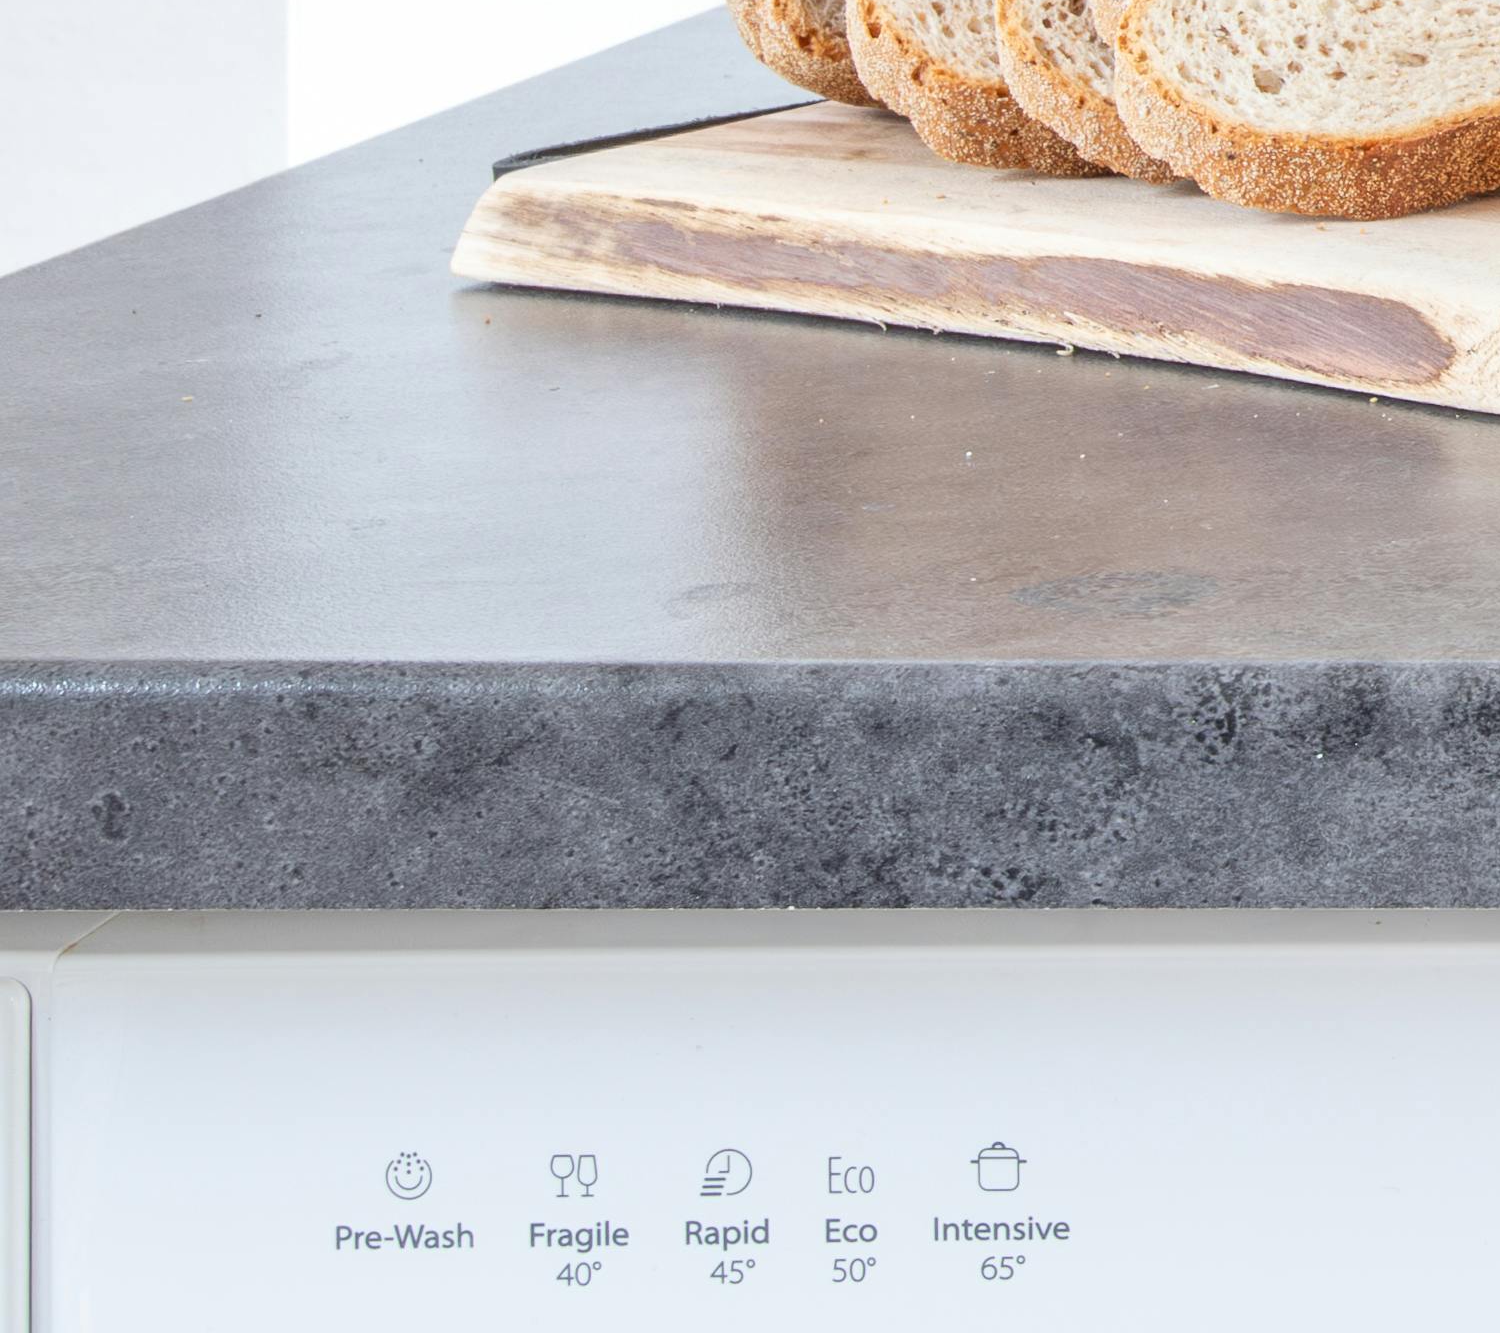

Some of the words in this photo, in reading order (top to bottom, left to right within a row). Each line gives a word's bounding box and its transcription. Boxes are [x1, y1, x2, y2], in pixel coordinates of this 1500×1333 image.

[828, 1156, 875, 1194] Eco
[335, 1222, 475, 1251] Pre-Wash
[529, 1220, 630, 1254] Fragile
[685, 1217, 770, 1251] Rapid
[825, 1218, 878, 1244] Eco
[933, 1215, 1071, 1242] Intensive
[556, 1261, 602, 1287] 40°
[709, 1258, 756, 1285] 45°
[832, 1256, 877, 1283] 50°
[980, 1254, 1026, 1281] 65°
